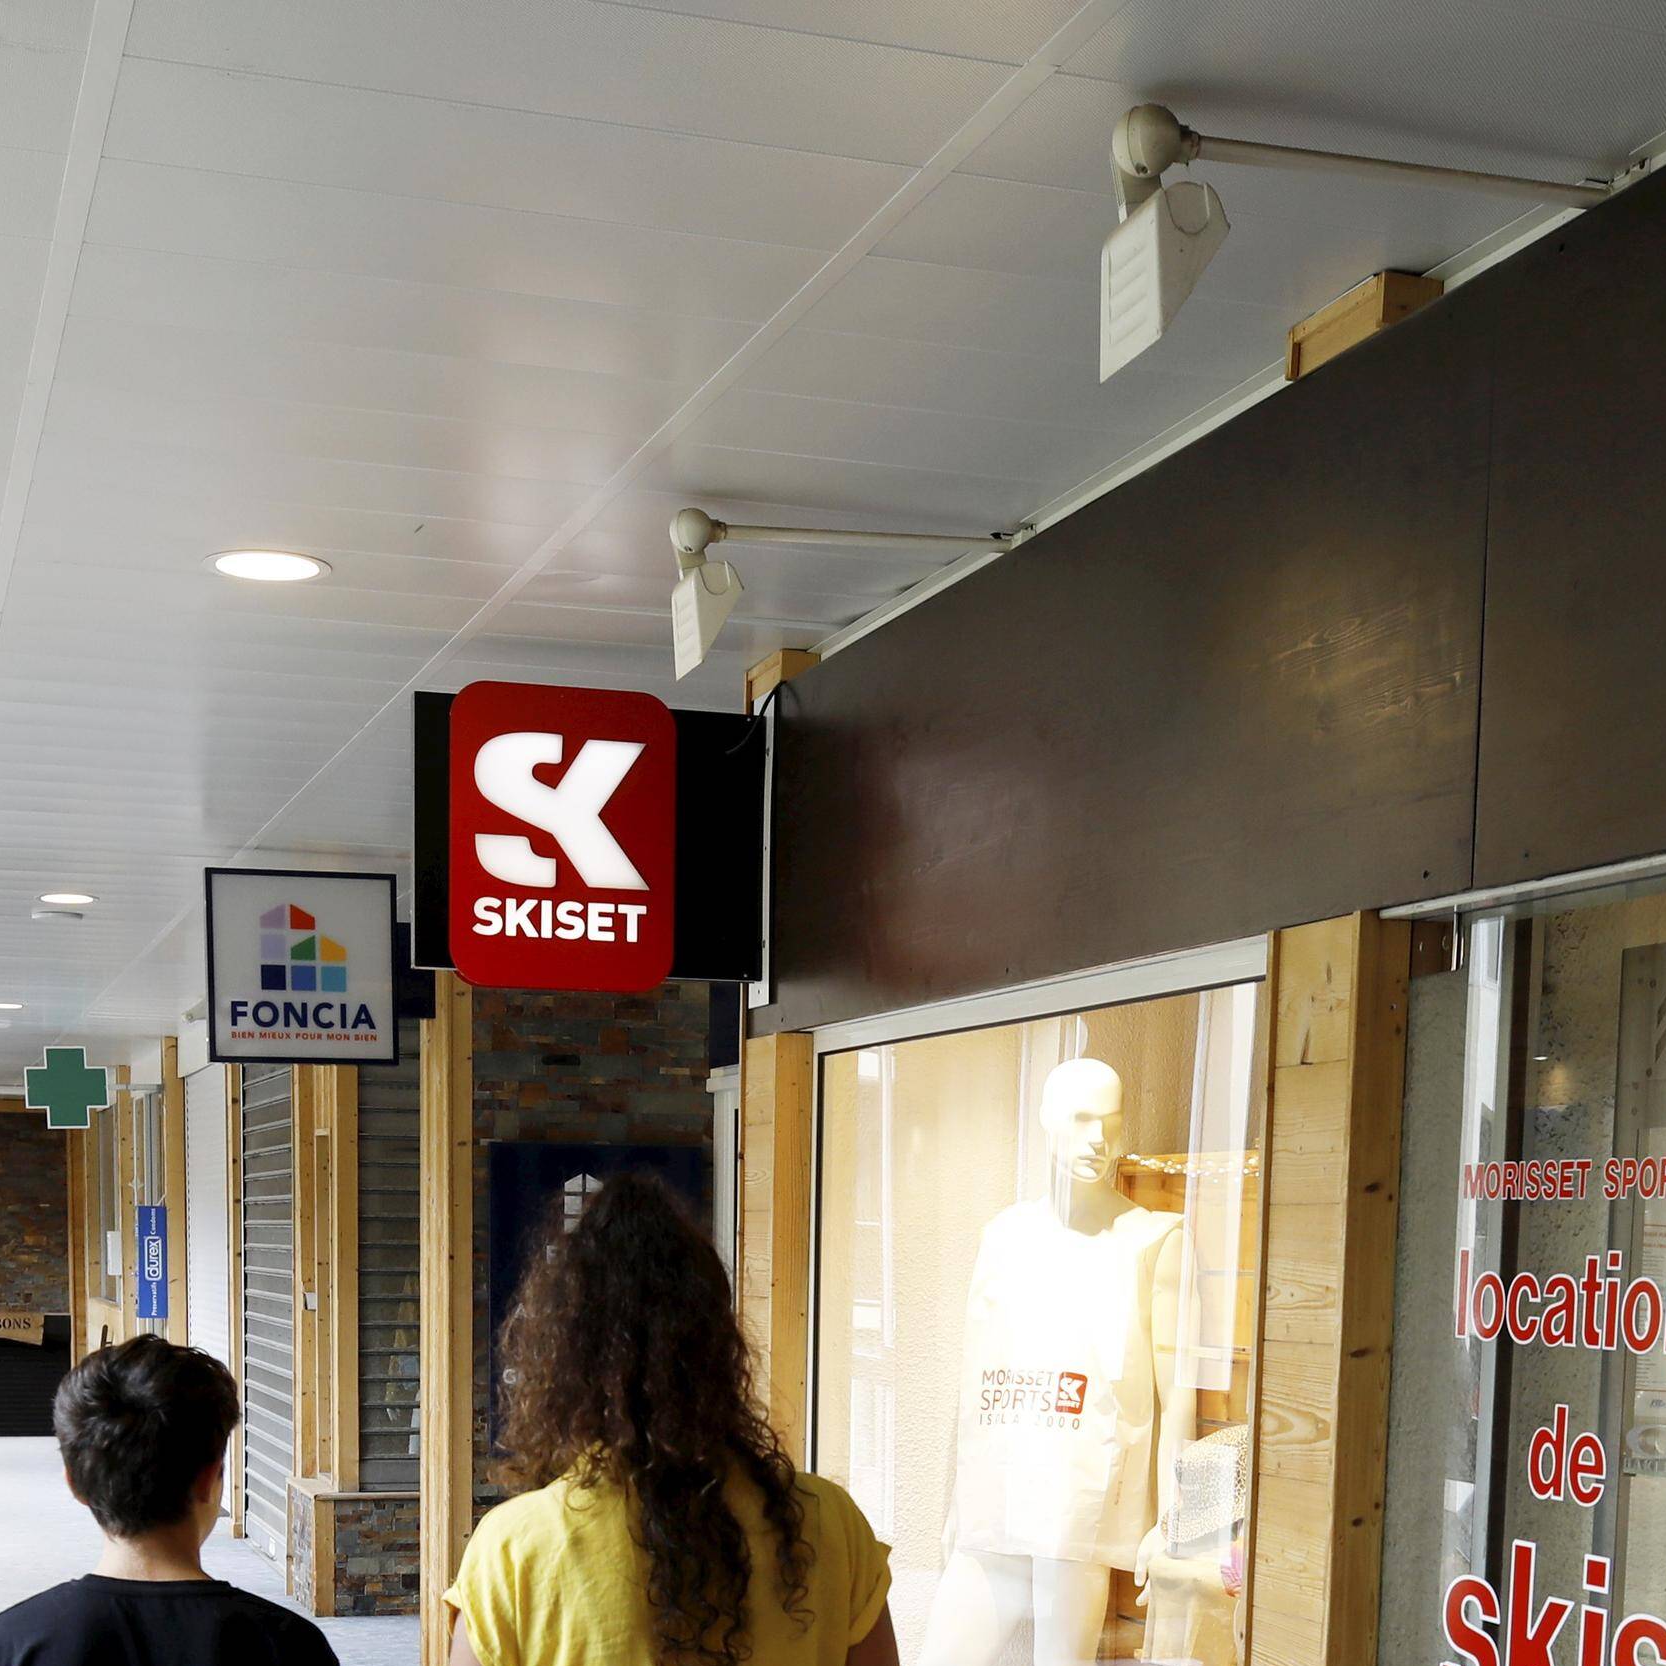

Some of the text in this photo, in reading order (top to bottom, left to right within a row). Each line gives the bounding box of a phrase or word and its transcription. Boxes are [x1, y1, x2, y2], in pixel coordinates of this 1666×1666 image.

[472, 896, 648, 943] SKISET
[231, 1000, 376, 1030] FONCIA
[231, 1031, 378, 1042] BIEN MIEUX POUR MON BIEN
[1463, 1159, 1593, 1200] MORISSET
[147, 1240, 159, 1277] durex
[980, 1388, 1052, 1412] SPORTS
[1528, 1404, 1606, 1507] de
